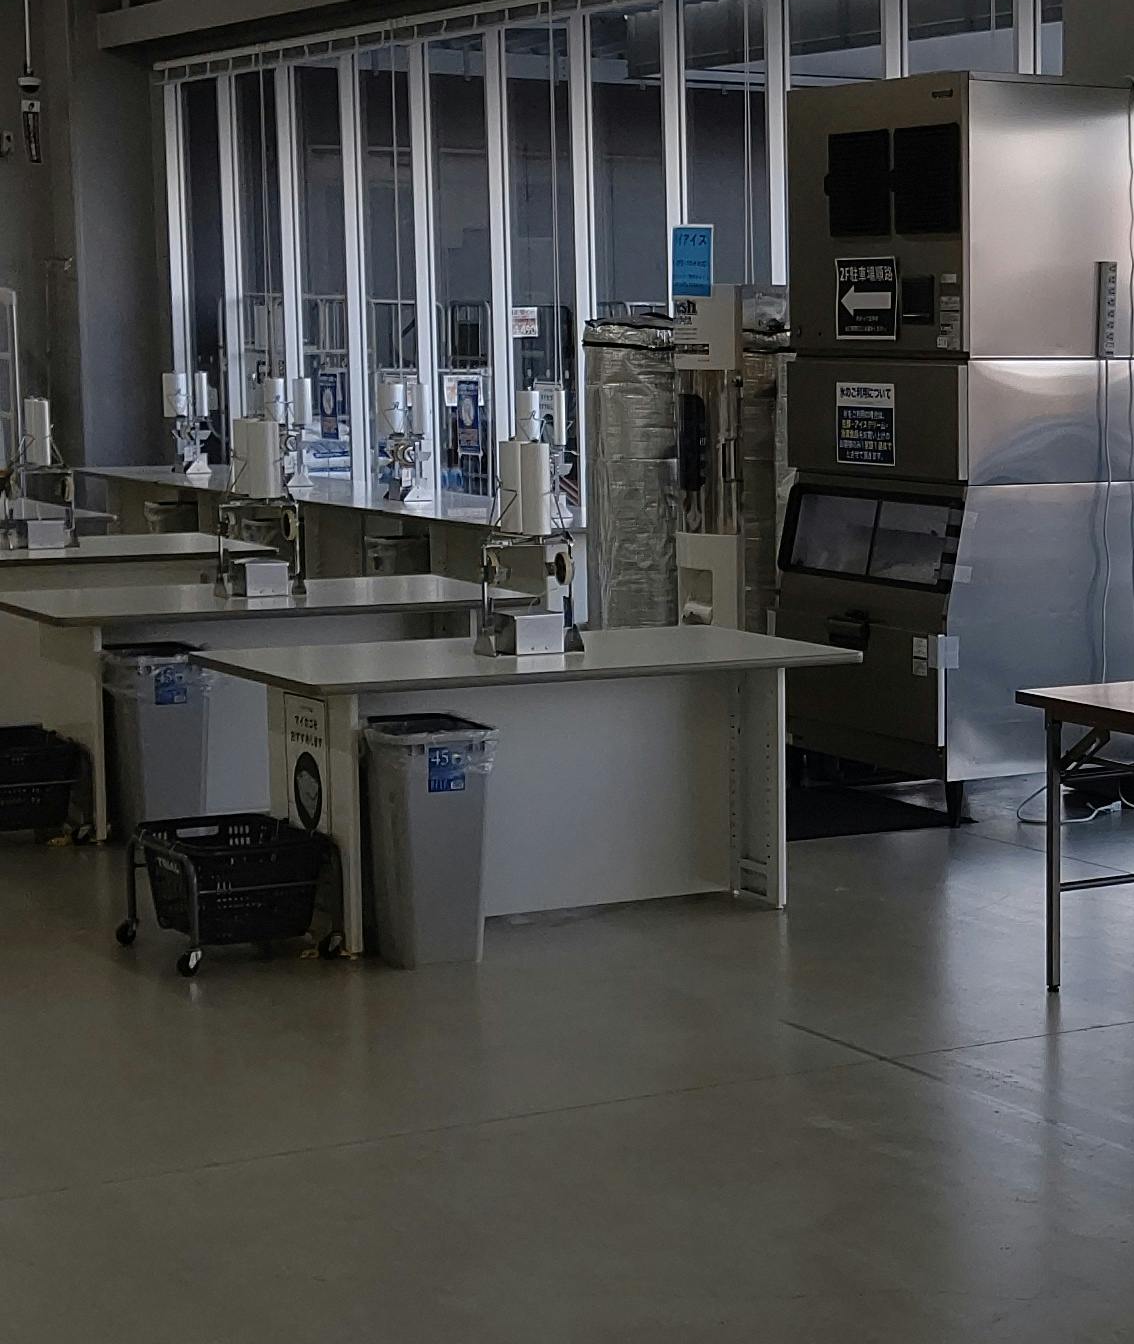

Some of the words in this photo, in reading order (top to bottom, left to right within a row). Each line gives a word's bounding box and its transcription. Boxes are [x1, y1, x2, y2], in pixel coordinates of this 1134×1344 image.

[840, 265, 893, 282] 2F駐車場順路
[840, 387, 891, 399] 氷のご利用について
[431, 750, 449, 766] 45
